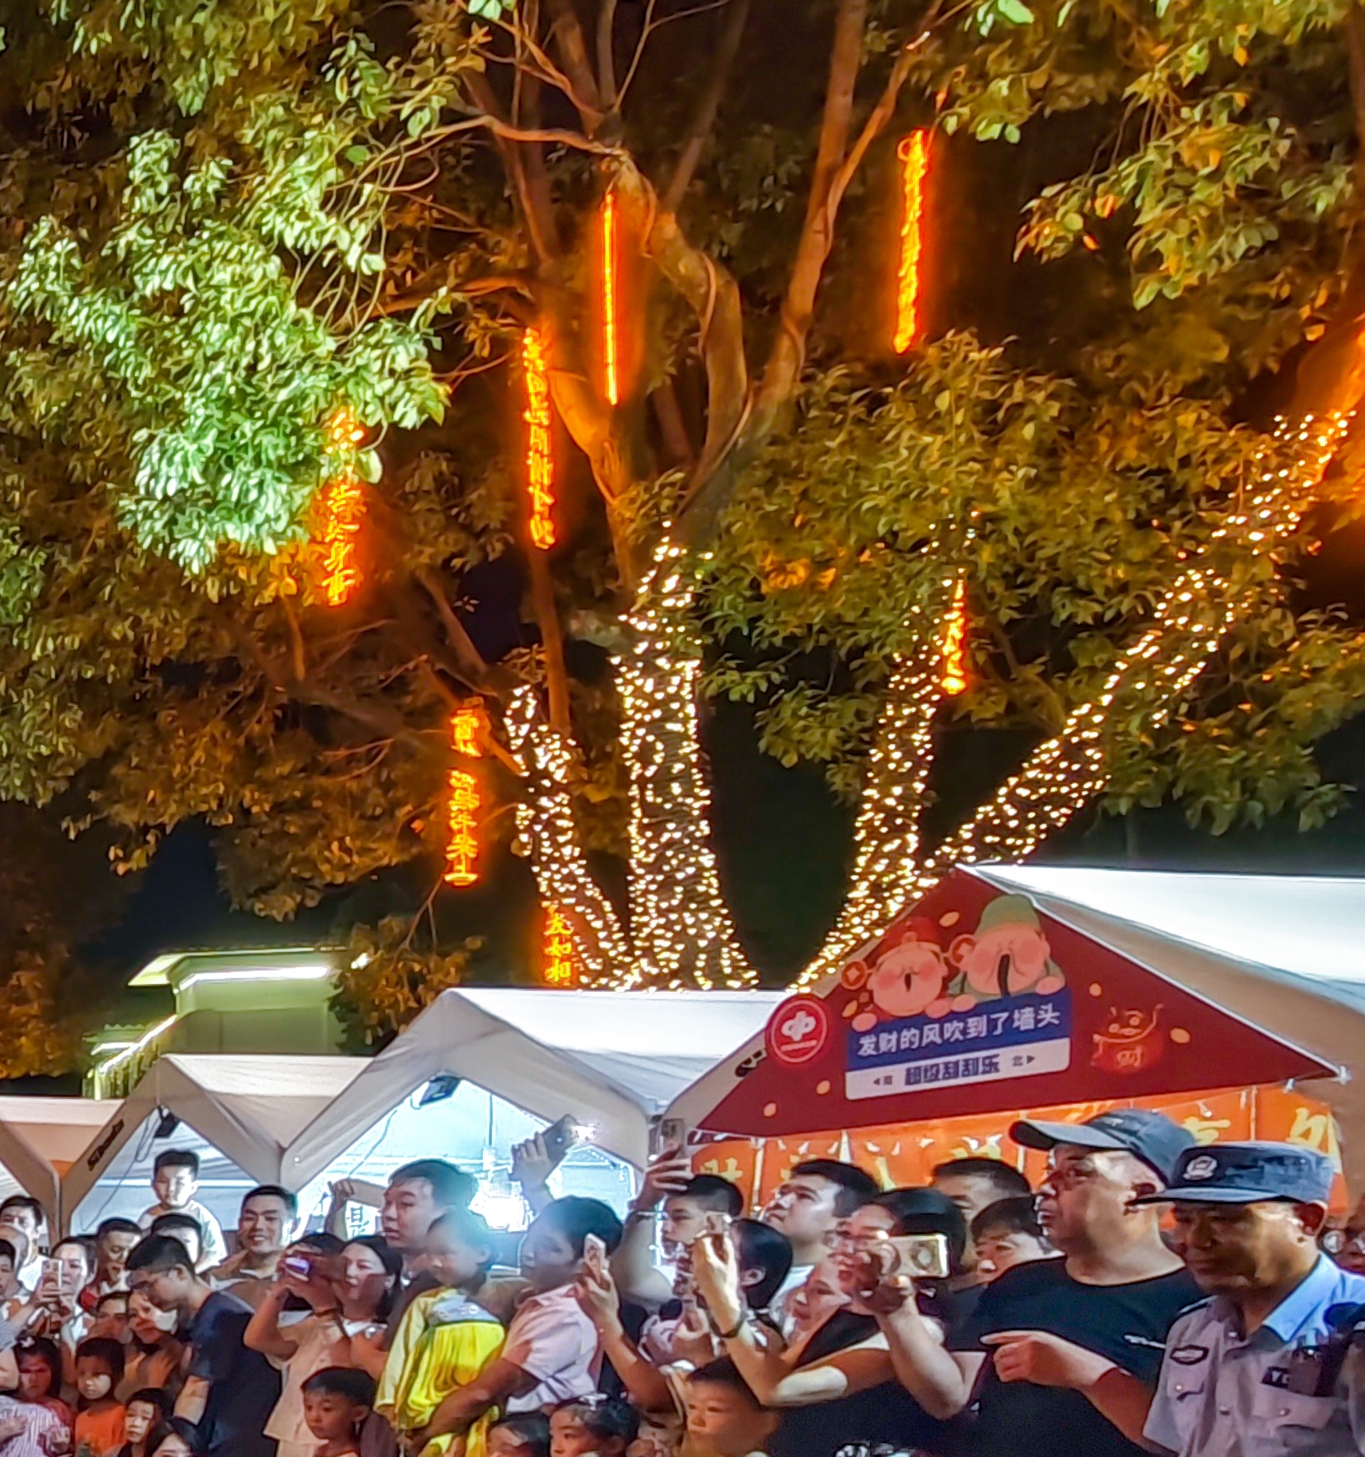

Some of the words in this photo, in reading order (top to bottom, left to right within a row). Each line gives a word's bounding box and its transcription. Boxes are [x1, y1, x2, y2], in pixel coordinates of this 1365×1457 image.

[856, 1002, 1061, 1058] 发财的风吹到了墙头
[903, 1053, 1001, 1086] 超级刮刮乐
